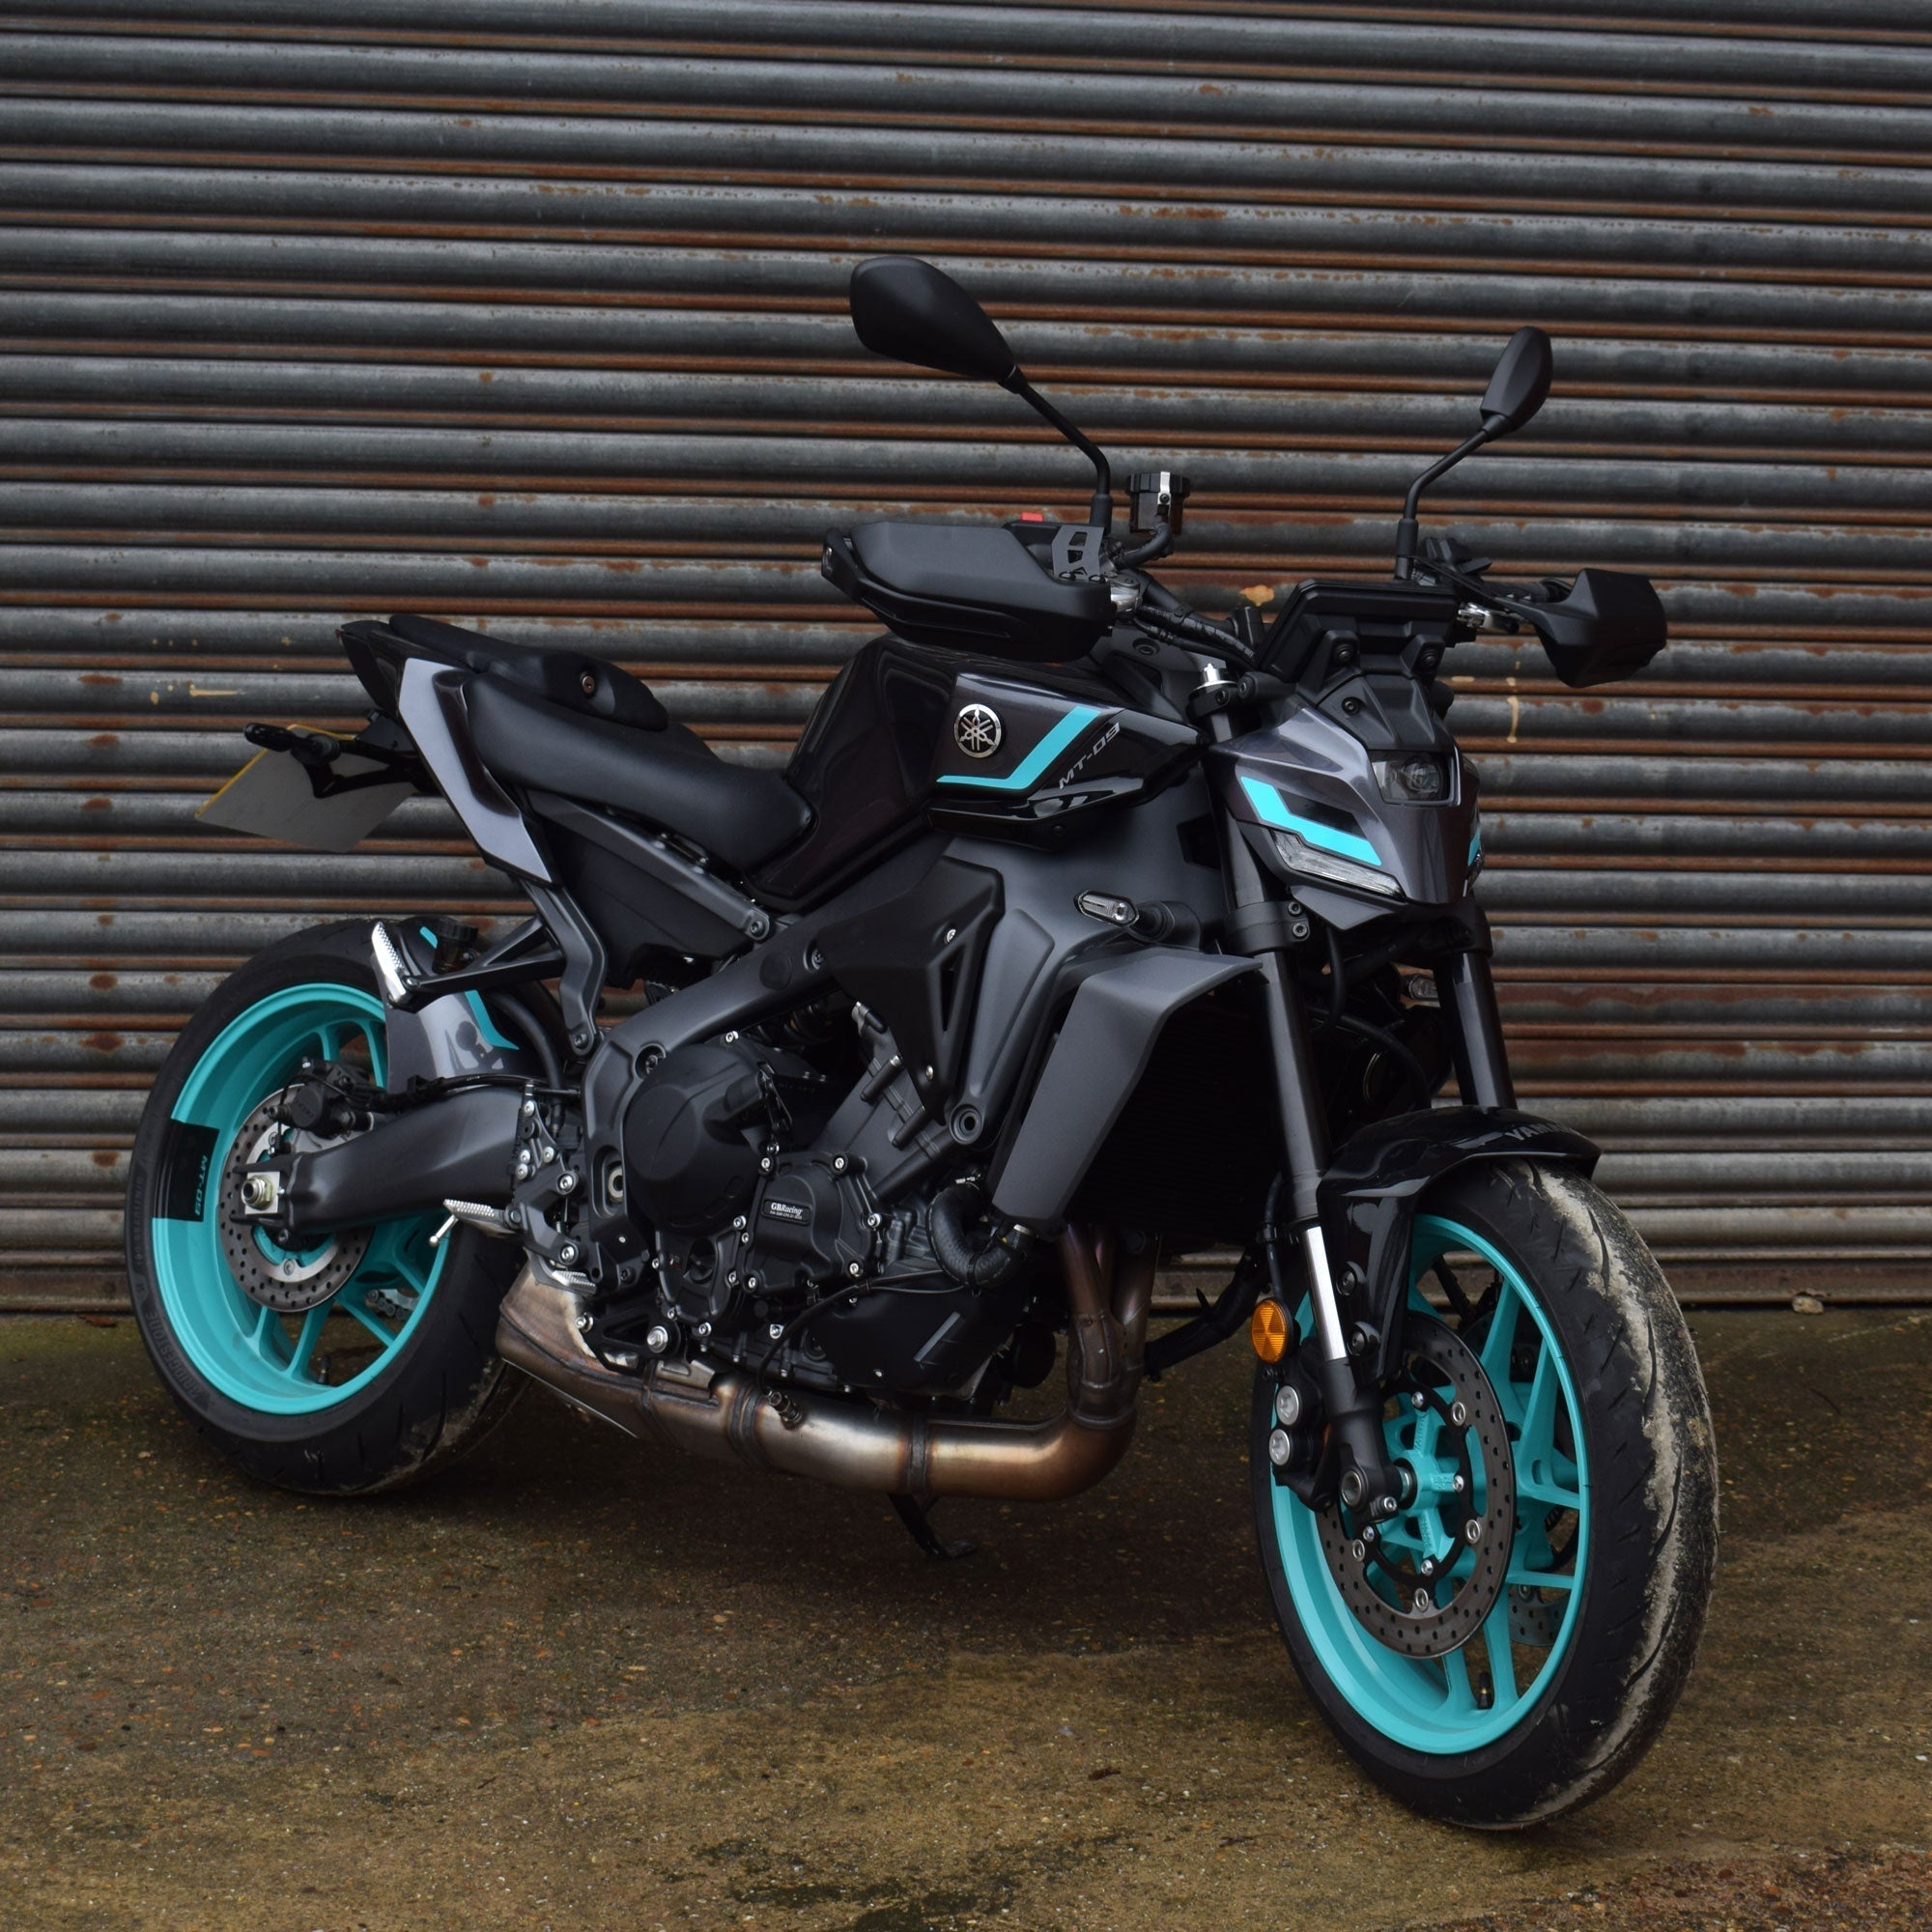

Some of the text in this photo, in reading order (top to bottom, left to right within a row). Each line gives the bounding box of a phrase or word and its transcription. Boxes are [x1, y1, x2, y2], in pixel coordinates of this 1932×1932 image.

[1059, 722, 1121, 789] MT-09
[193, 1154, 209, 1216] MT-09
[770, 1202, 804, 1217] GBRacing
